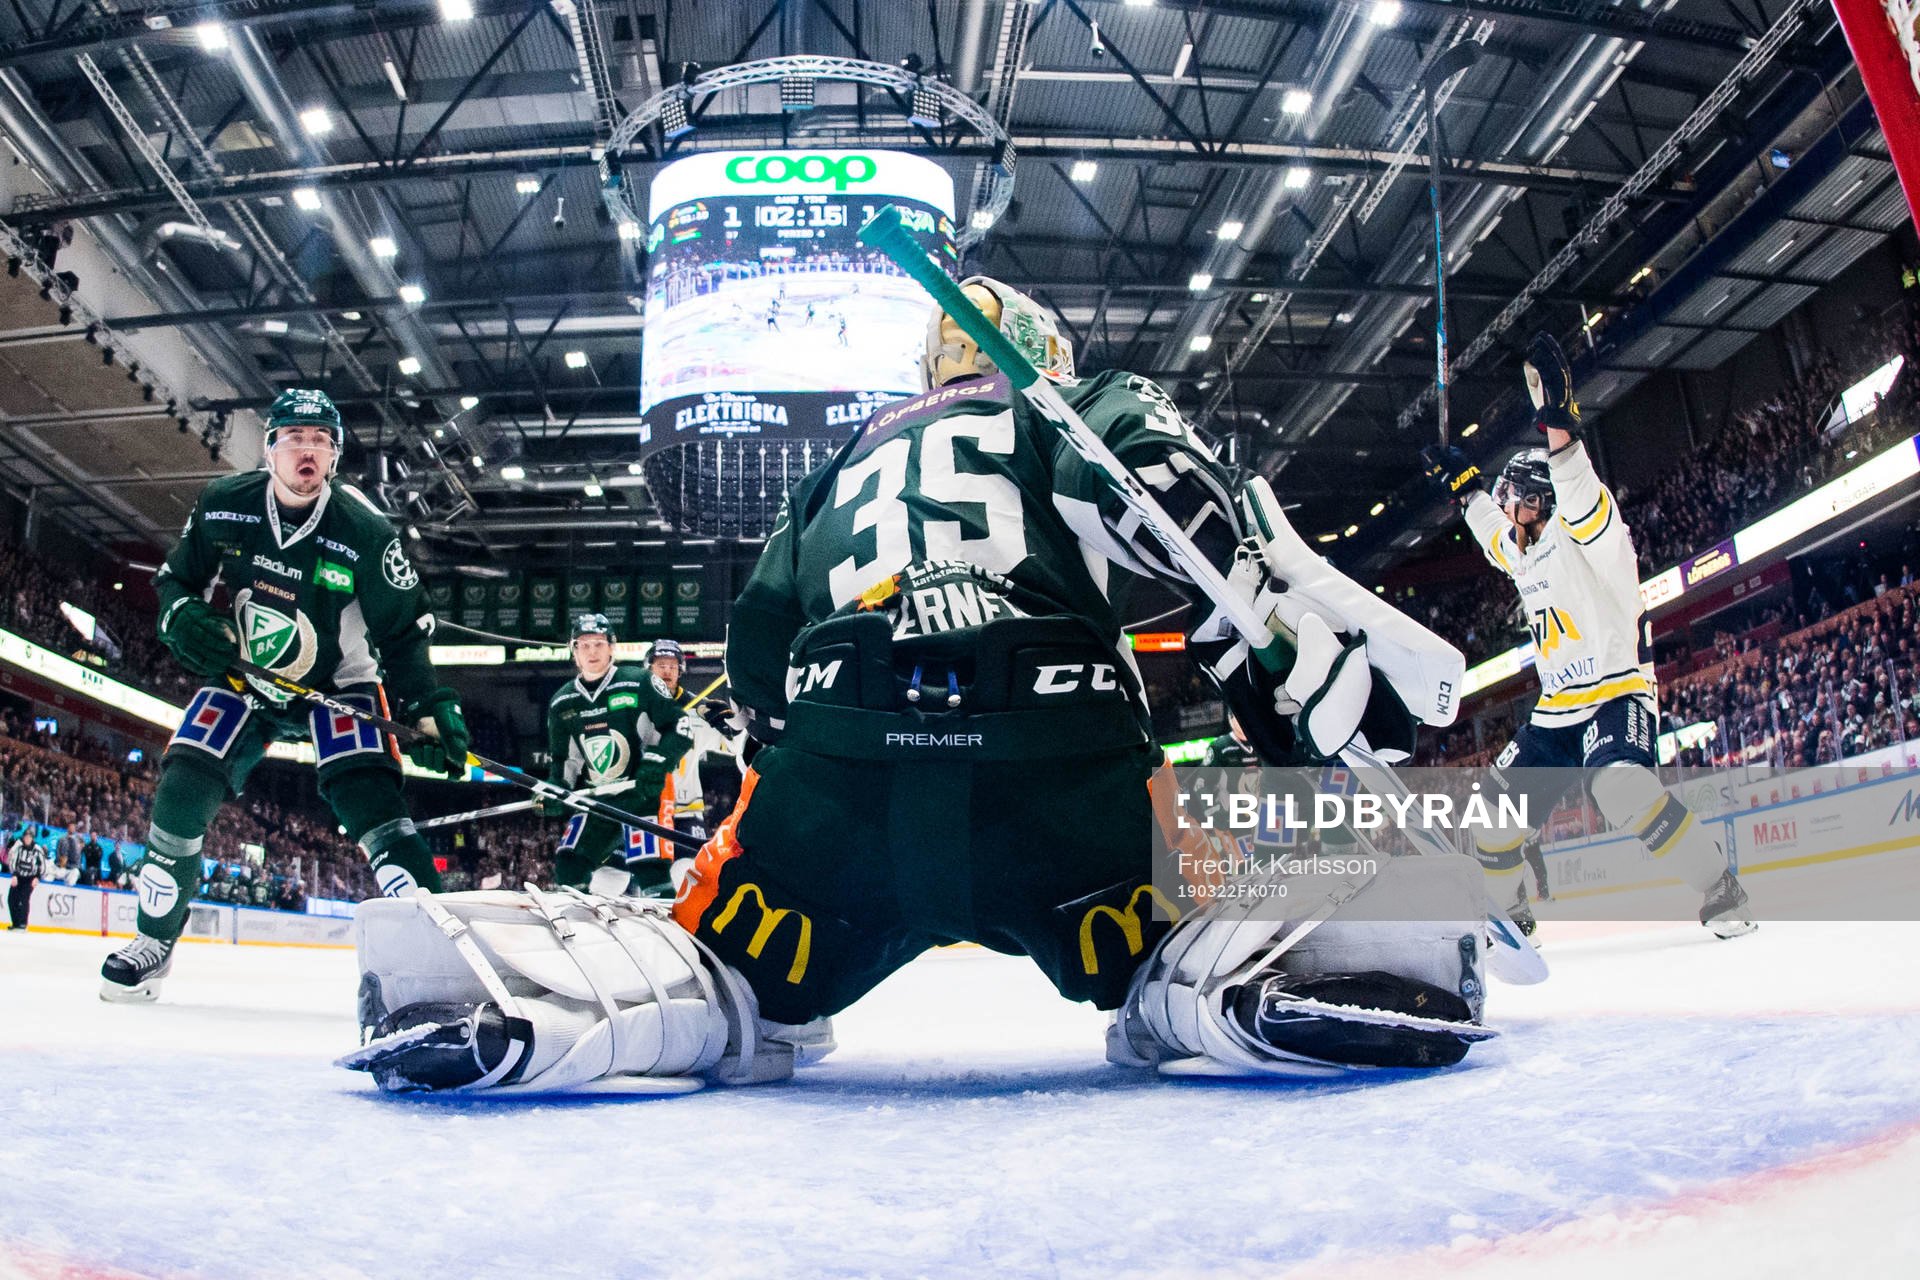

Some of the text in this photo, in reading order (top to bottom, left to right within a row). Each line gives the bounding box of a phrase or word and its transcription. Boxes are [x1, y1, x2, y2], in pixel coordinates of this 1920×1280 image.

[725, 155, 876, 191] coop
[204, 511, 262, 524] MOELVEN
[827, 408, 1026, 613] 35
[252, 554, 303, 581] stadium
[253, 580, 296, 601] LÖFBERGS
[1436, 680, 1453, 716] CCM
[885, 732, 984, 748] PREMIER
[1753, 821, 1798, 847] MAXI
